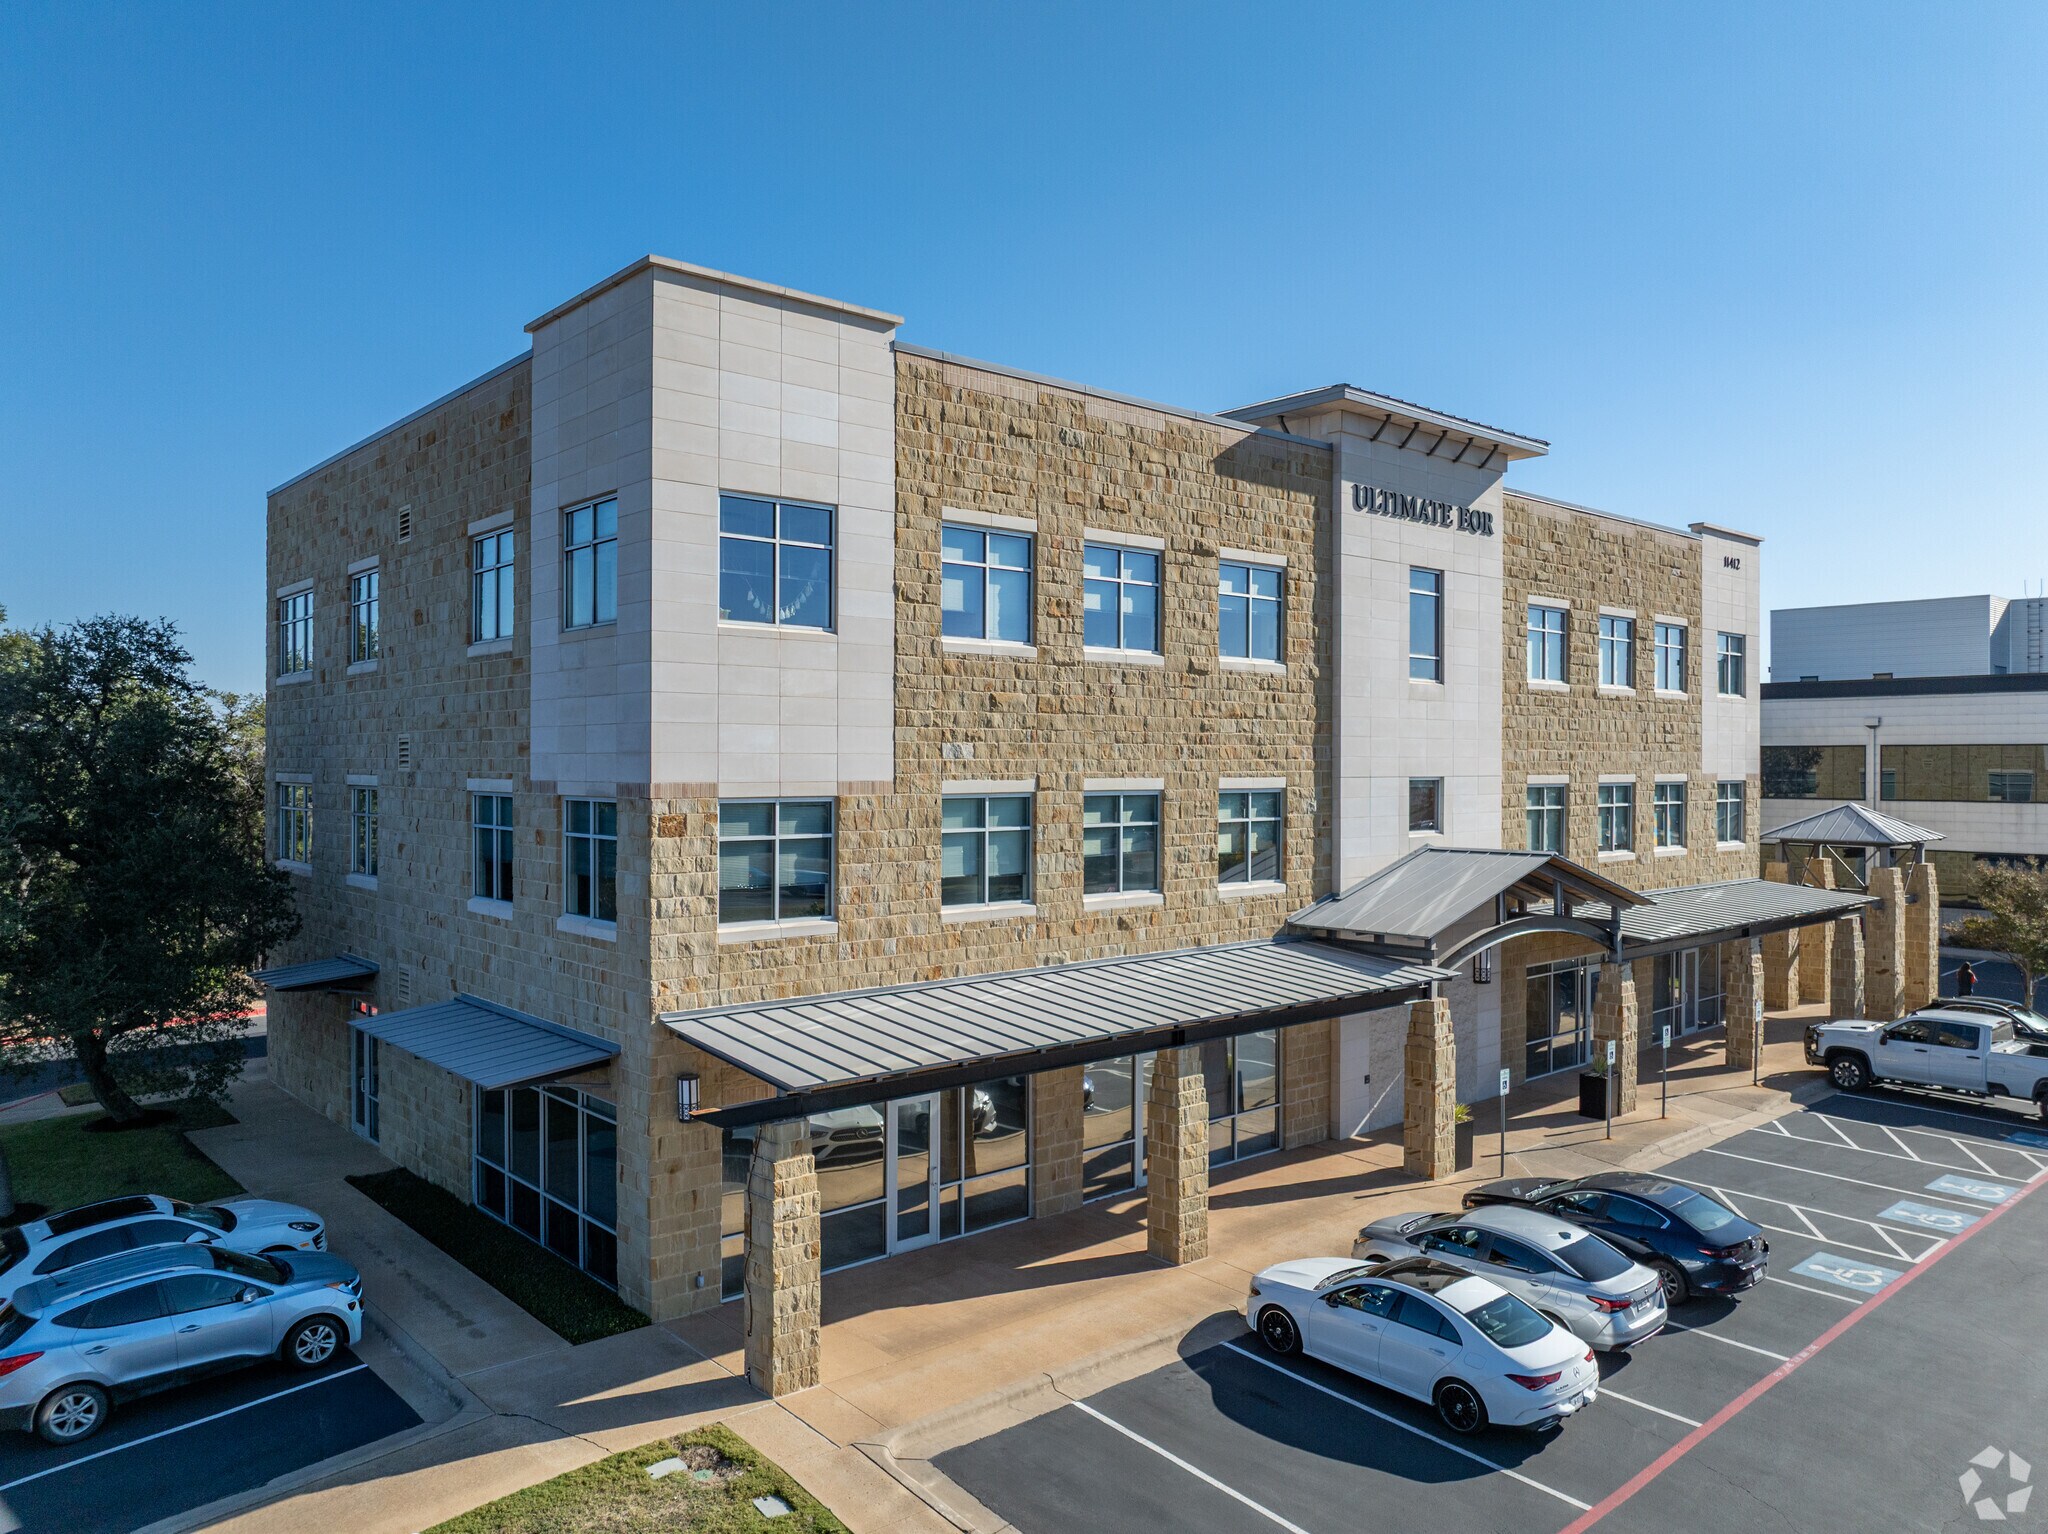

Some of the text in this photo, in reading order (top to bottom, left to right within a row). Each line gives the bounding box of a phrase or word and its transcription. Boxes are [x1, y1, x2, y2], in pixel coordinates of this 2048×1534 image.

[1351, 483, 1494, 536] ULTIMATE EOR
[1723, 556, 1741, 570] 11412
